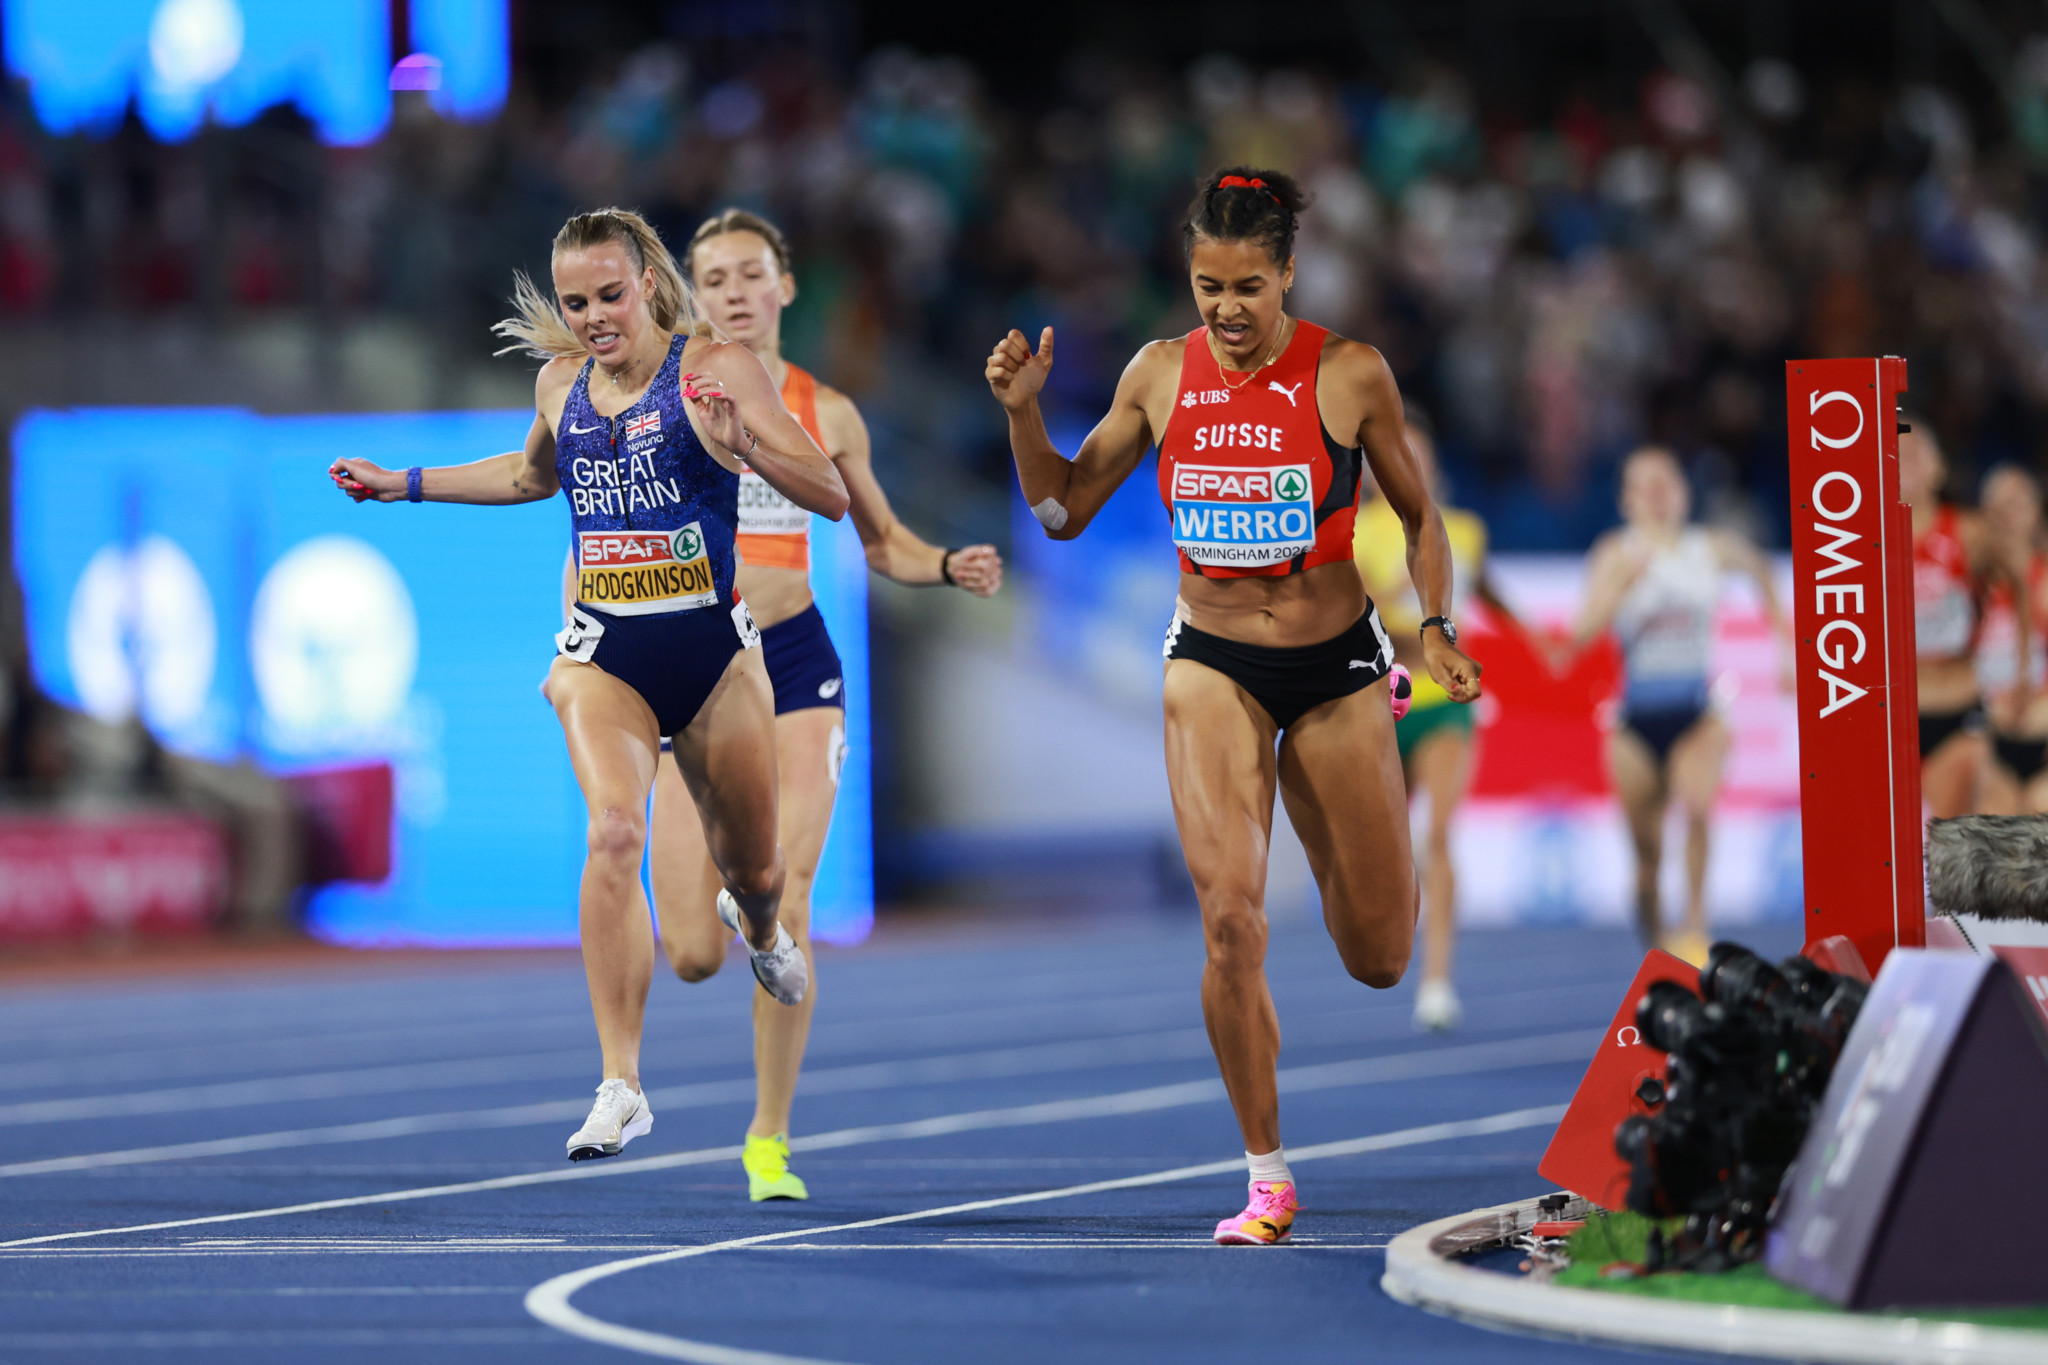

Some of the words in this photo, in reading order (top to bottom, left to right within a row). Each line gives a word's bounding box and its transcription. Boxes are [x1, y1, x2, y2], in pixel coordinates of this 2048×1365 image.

[1199, 389, 1230, 405] UBS
[627, 434, 664, 454] Novuna
[572, 448, 657, 487] GREAT
[572, 477, 681, 516] BRITAIN
[1177, 473, 1269, 498] SPAR
[1176, 507, 1308, 541] WERRO
[583, 537, 673, 562] SPAR
[580, 561, 710, 600] HODGKINSON
[1811, 471, 1869, 719] OMEGA
